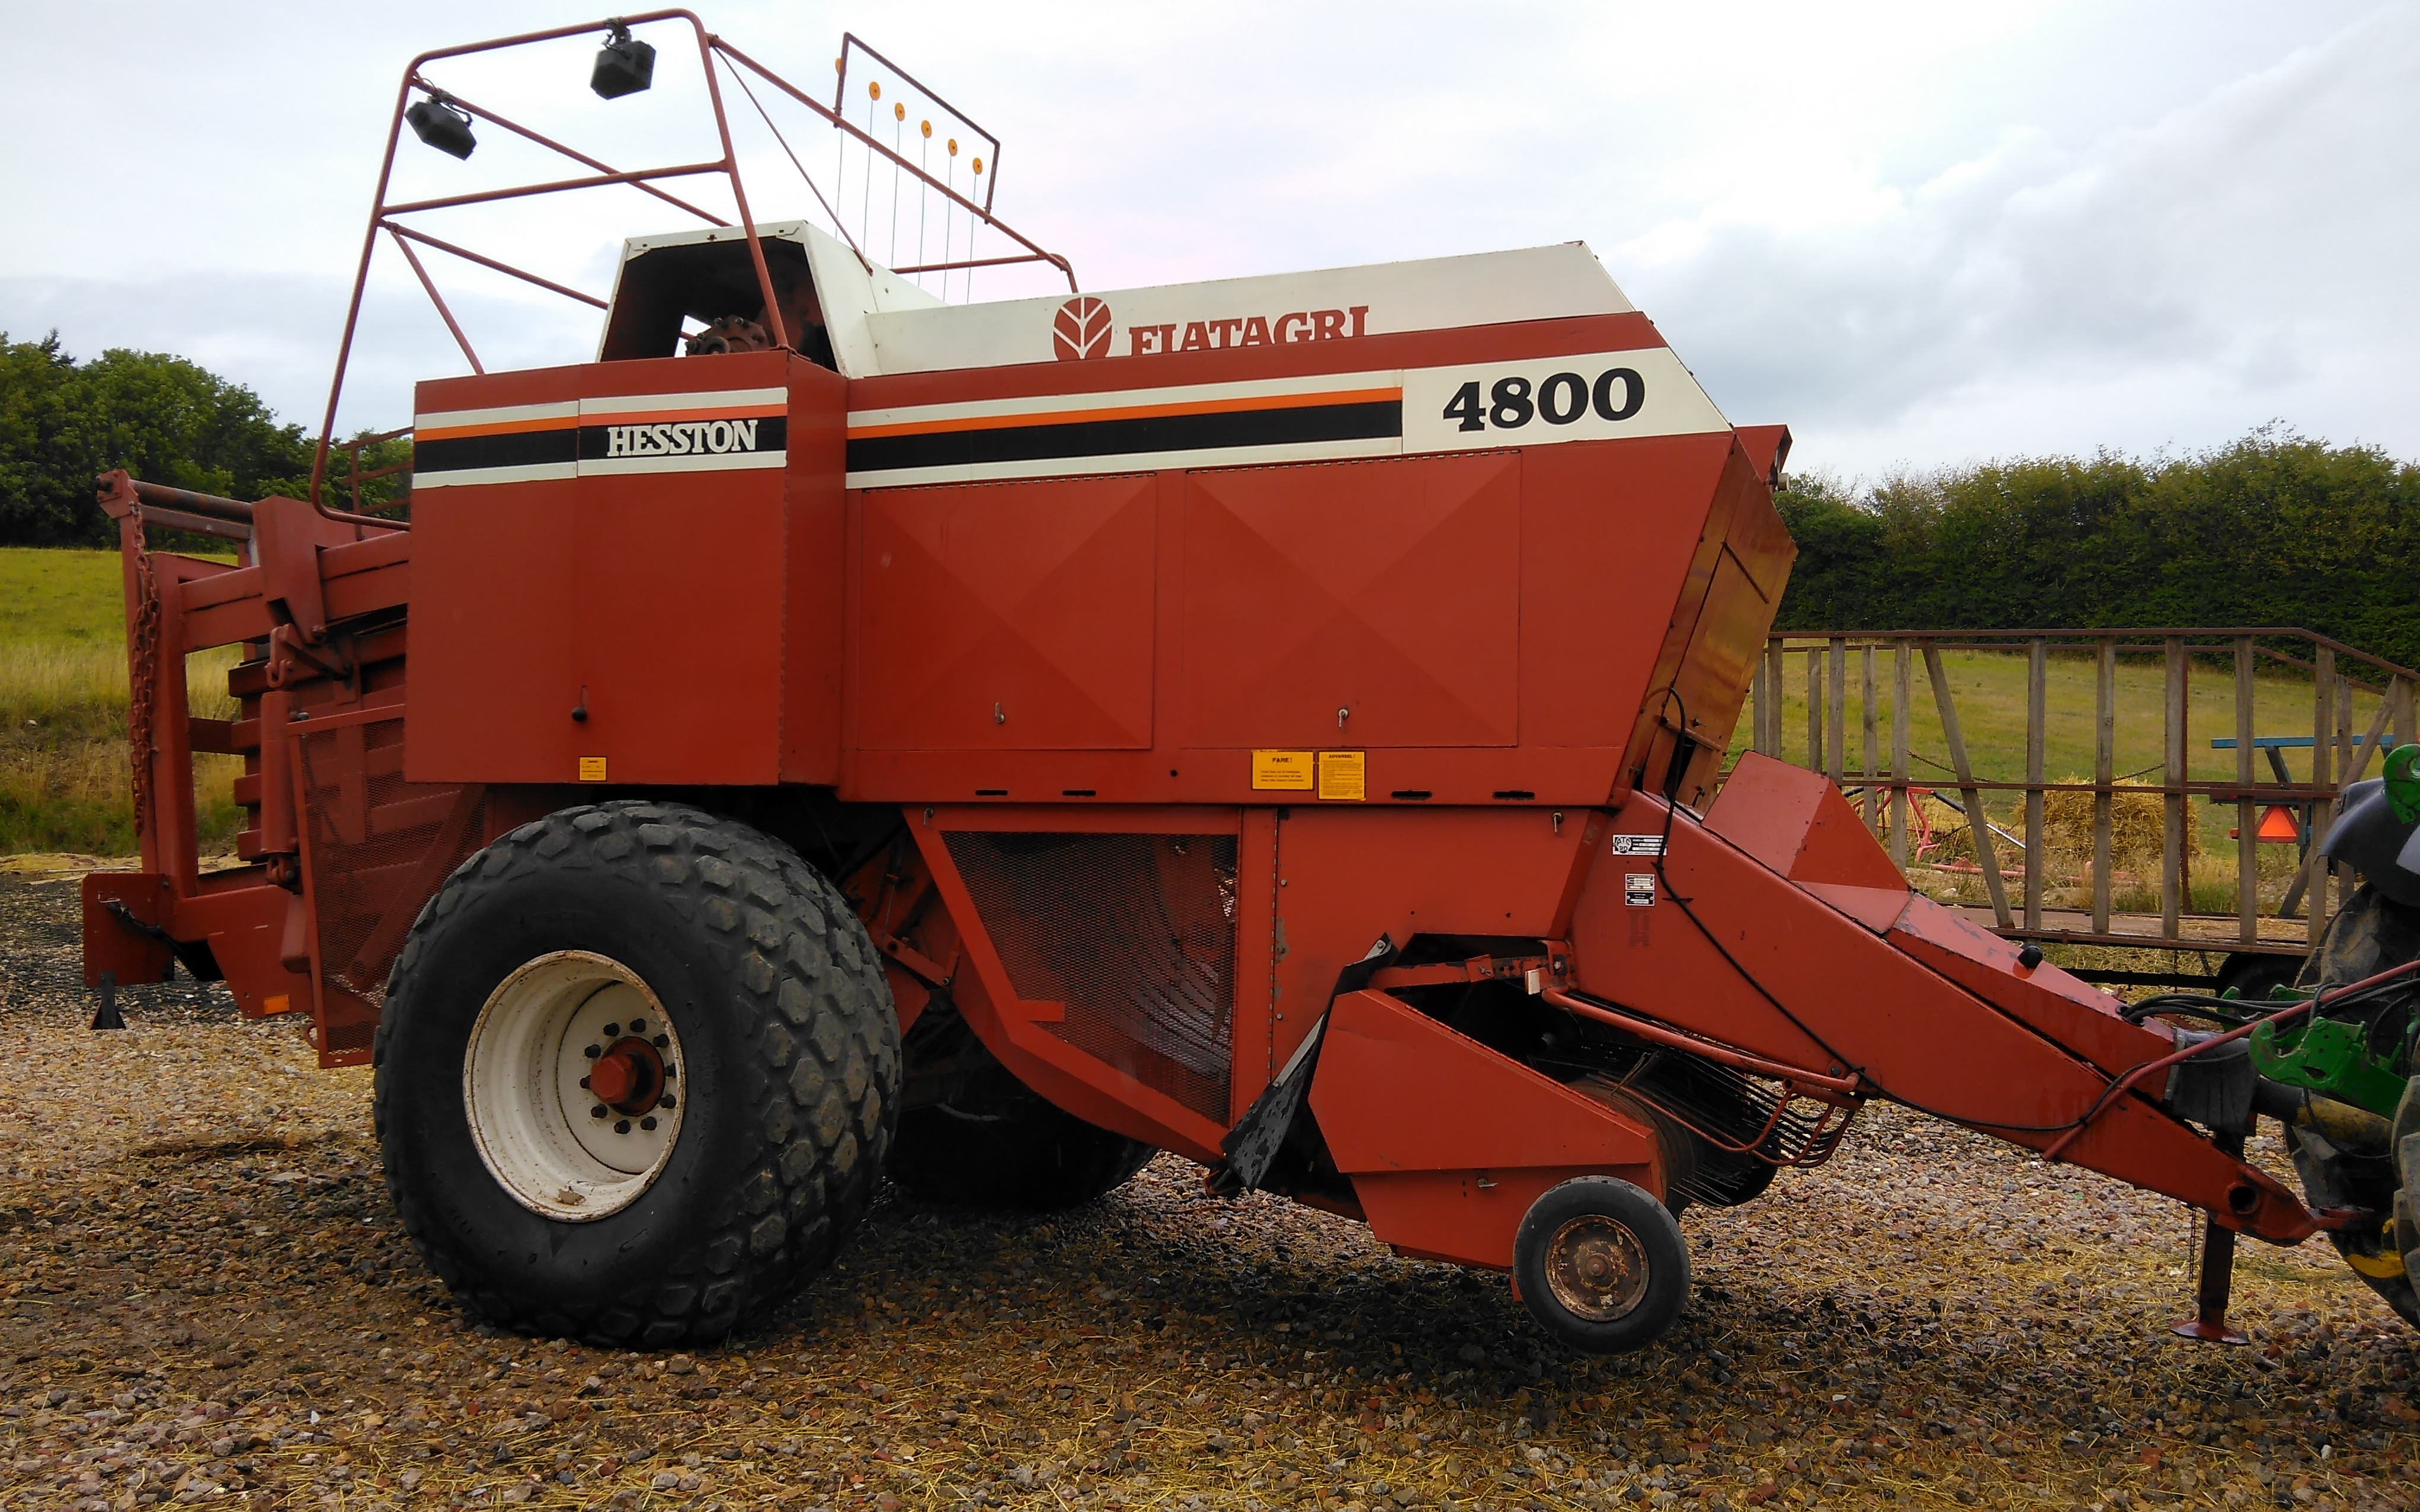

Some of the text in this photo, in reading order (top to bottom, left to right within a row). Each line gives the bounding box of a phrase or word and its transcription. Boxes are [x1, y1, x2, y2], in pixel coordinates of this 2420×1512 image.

[1128, 305, 1369, 356] FIATAGRI
[1442, 367, 1646, 432] 4800
[607, 419, 758, 457] HESSTON
